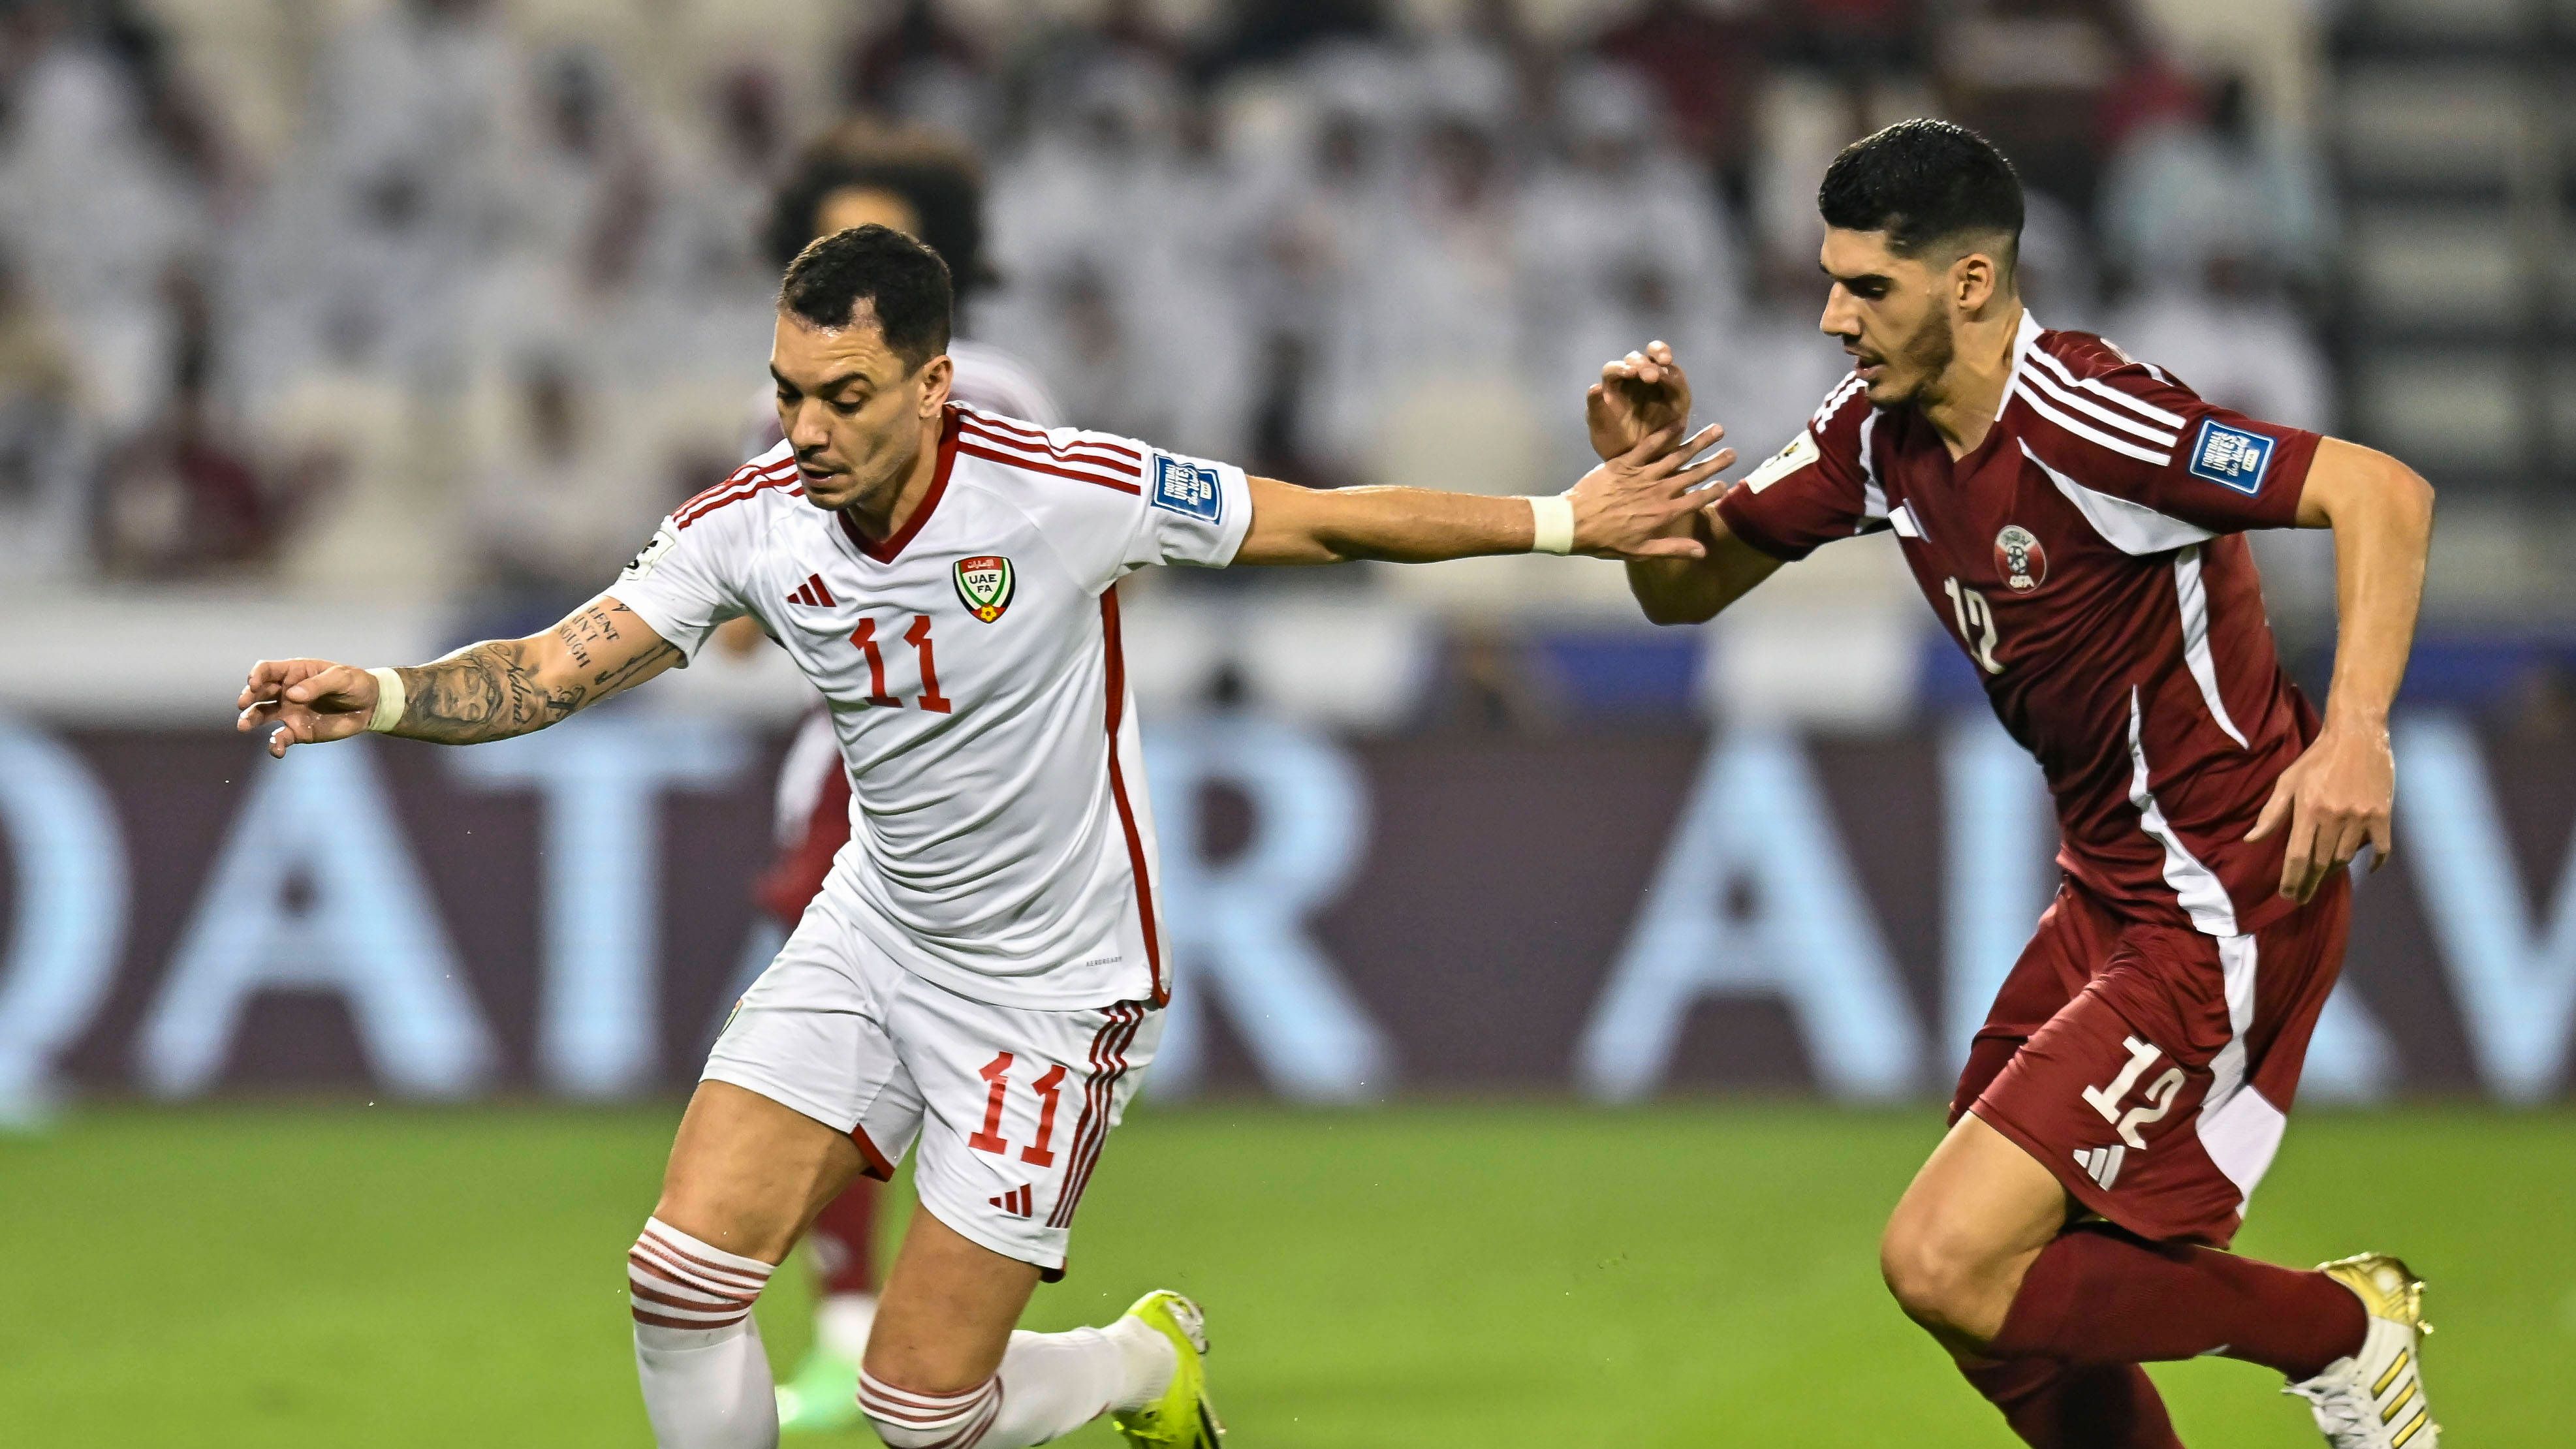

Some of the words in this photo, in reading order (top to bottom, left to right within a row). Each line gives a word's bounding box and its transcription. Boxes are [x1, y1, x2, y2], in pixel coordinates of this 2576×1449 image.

[588, 607, 621, 640] LENT
[969, 574, 997, 584] UAE
[977, 584, 993, 593] FA
[1944, 576, 2005, 675] 12
[849, 615, 952, 715] 11
[968, 1051, 1067, 1168] 11
[2081, 1035, 2186, 1150] 12
